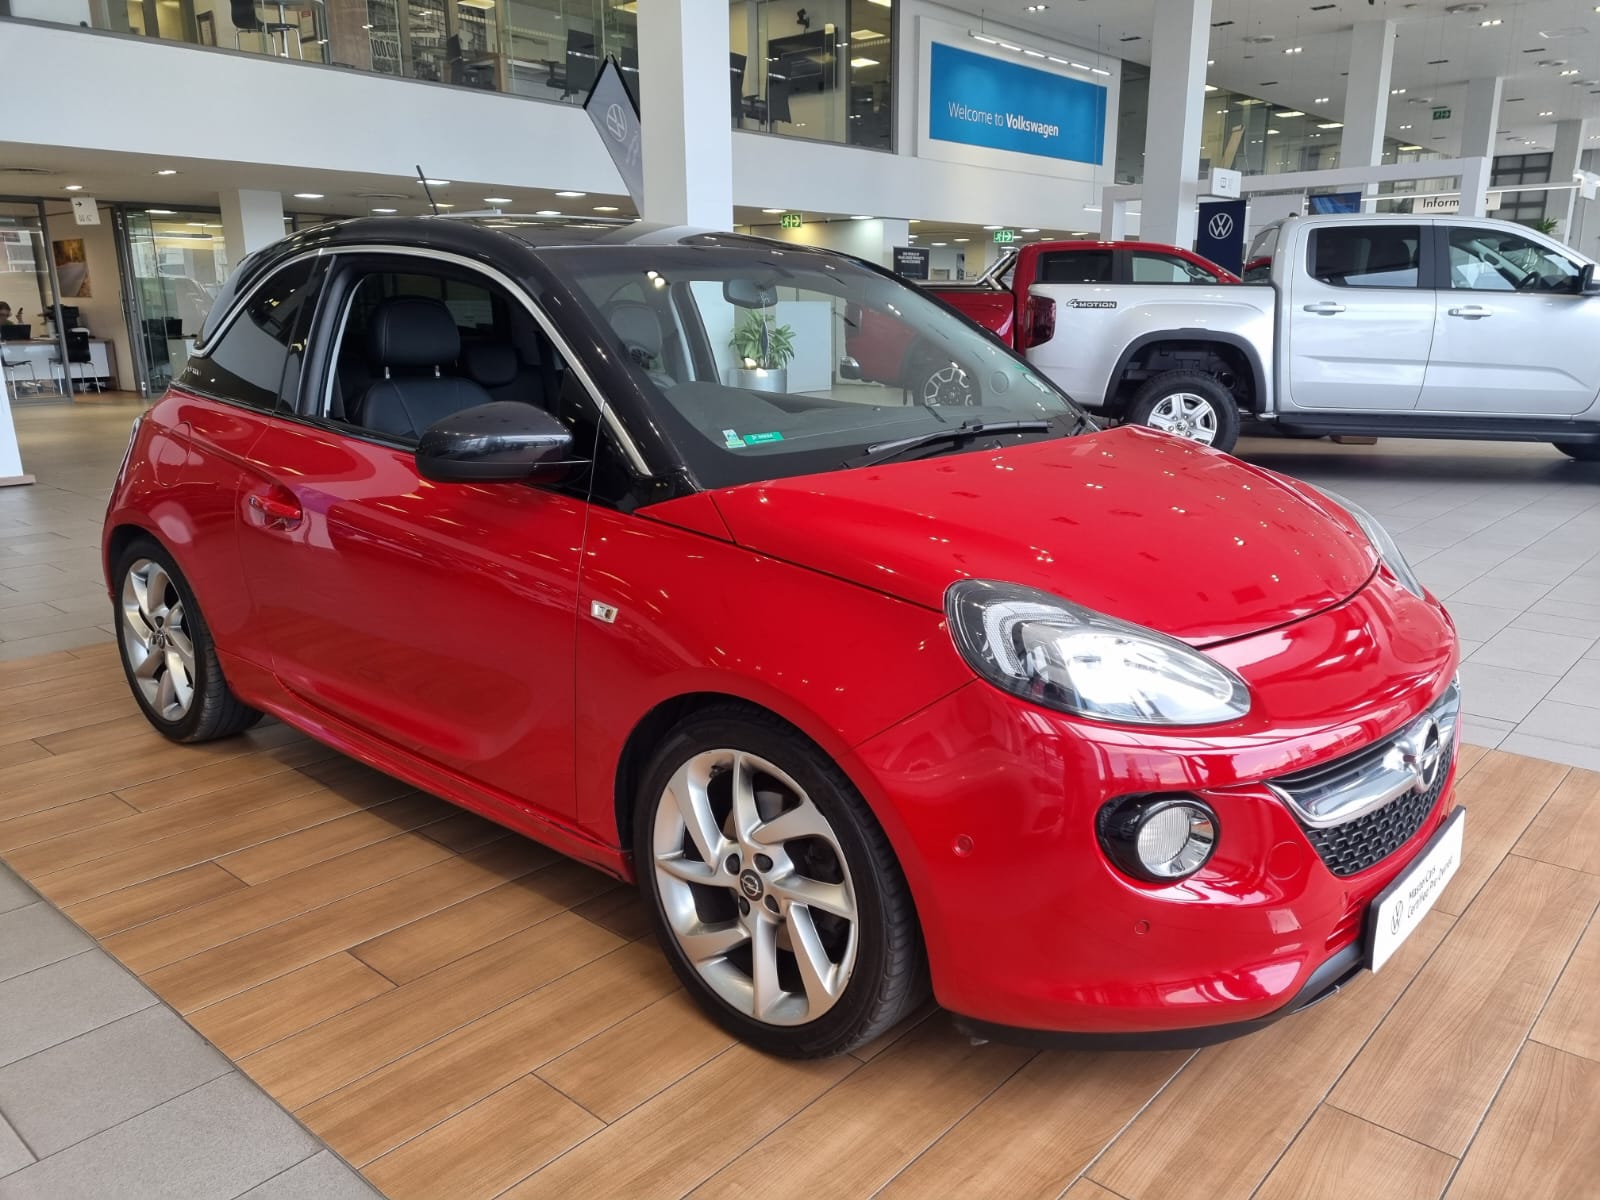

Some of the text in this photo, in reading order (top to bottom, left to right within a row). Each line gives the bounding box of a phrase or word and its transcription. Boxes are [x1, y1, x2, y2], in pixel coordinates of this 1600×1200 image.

[948, 101, 1059, 138] Welcome to Volkswagen
[1066, 298, 1117, 308] 4MOTION
